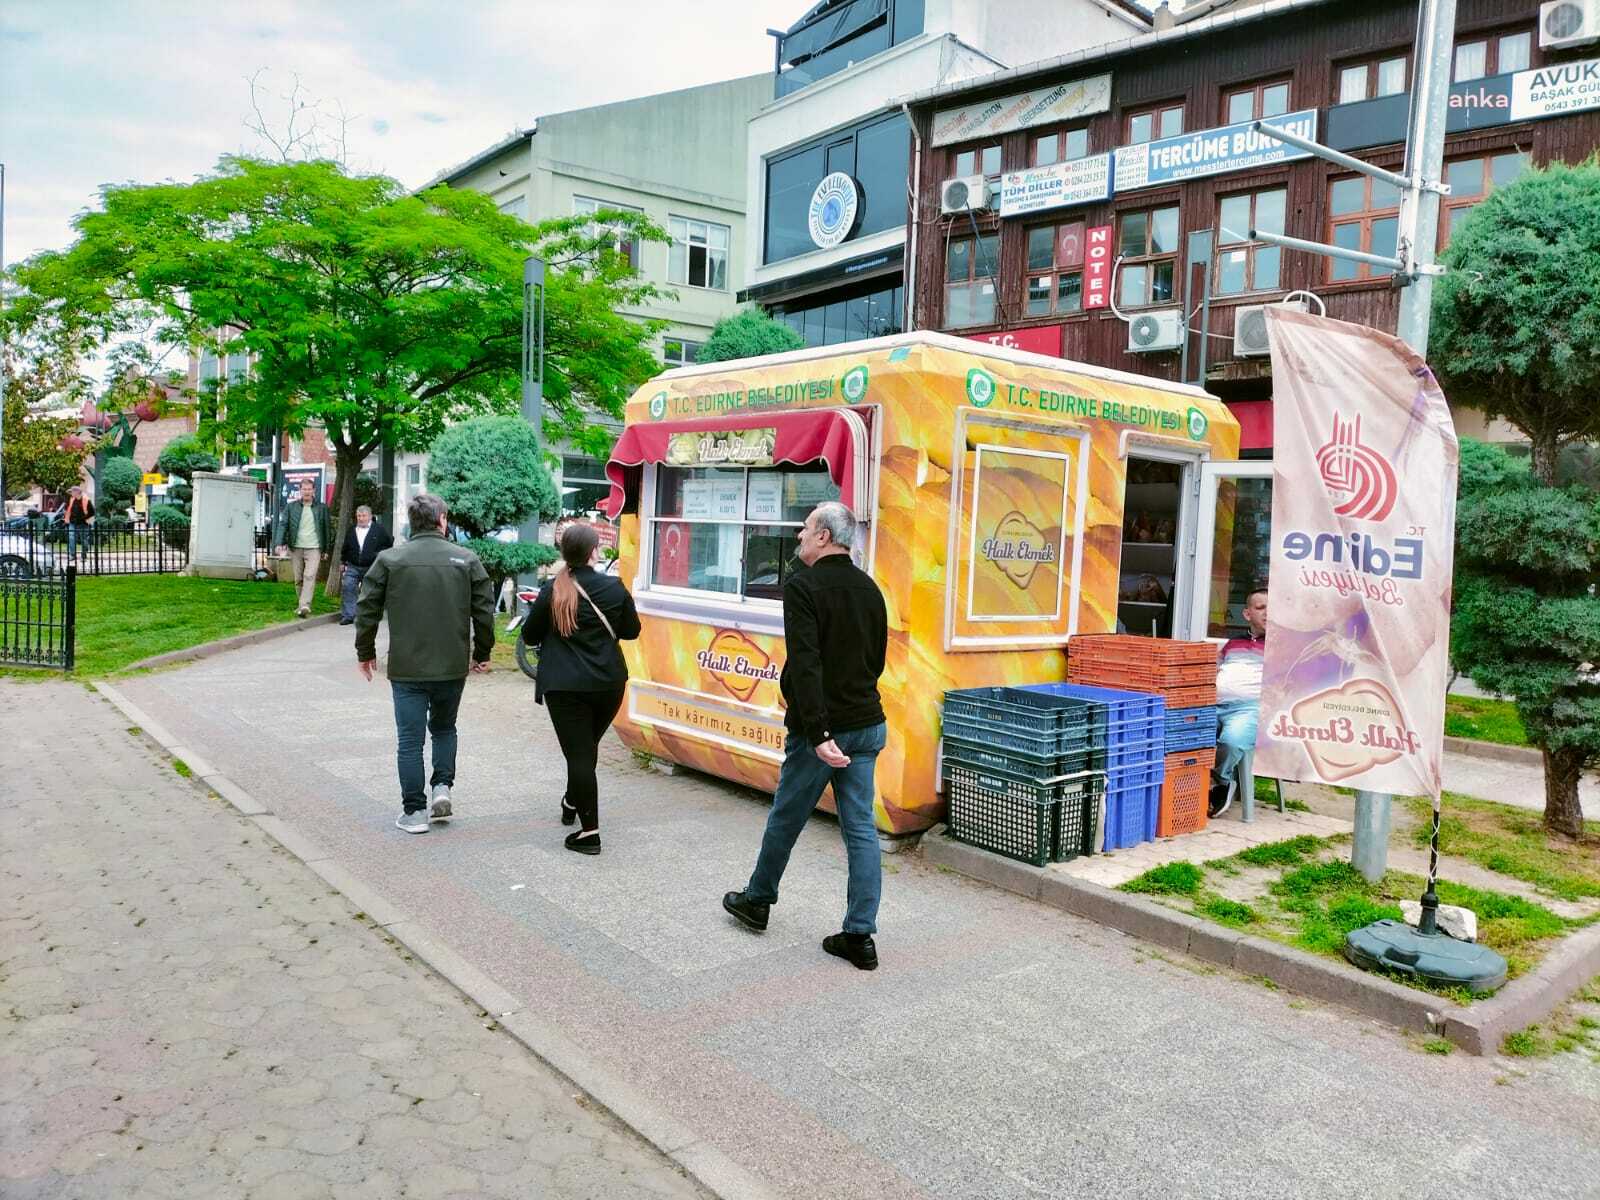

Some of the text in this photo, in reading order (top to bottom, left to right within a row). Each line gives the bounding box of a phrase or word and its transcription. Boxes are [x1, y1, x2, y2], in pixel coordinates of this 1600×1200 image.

[1530, 87, 1574, 102] BAŞAK
[1544, 100, 1568, 112] 0543
[1572, 97, 1588, 108] 391
[958, 102, 1003, 137] TRANSLATION
[1151, 136, 1229, 170] TERCÜME
[1088, 230, 1106, 306] NOTER
[672, 396, 693, 414] T.C.
[1006, 383, 1033, 408] T.C.
[1102, 400, 1182, 430] BELEDİYESİ
[698, 437, 768, 461] Halk Ekmek
[981, 538, 1054, 560] Halk Ekmek
[697, 650, 780, 680] Halk Ekmek
